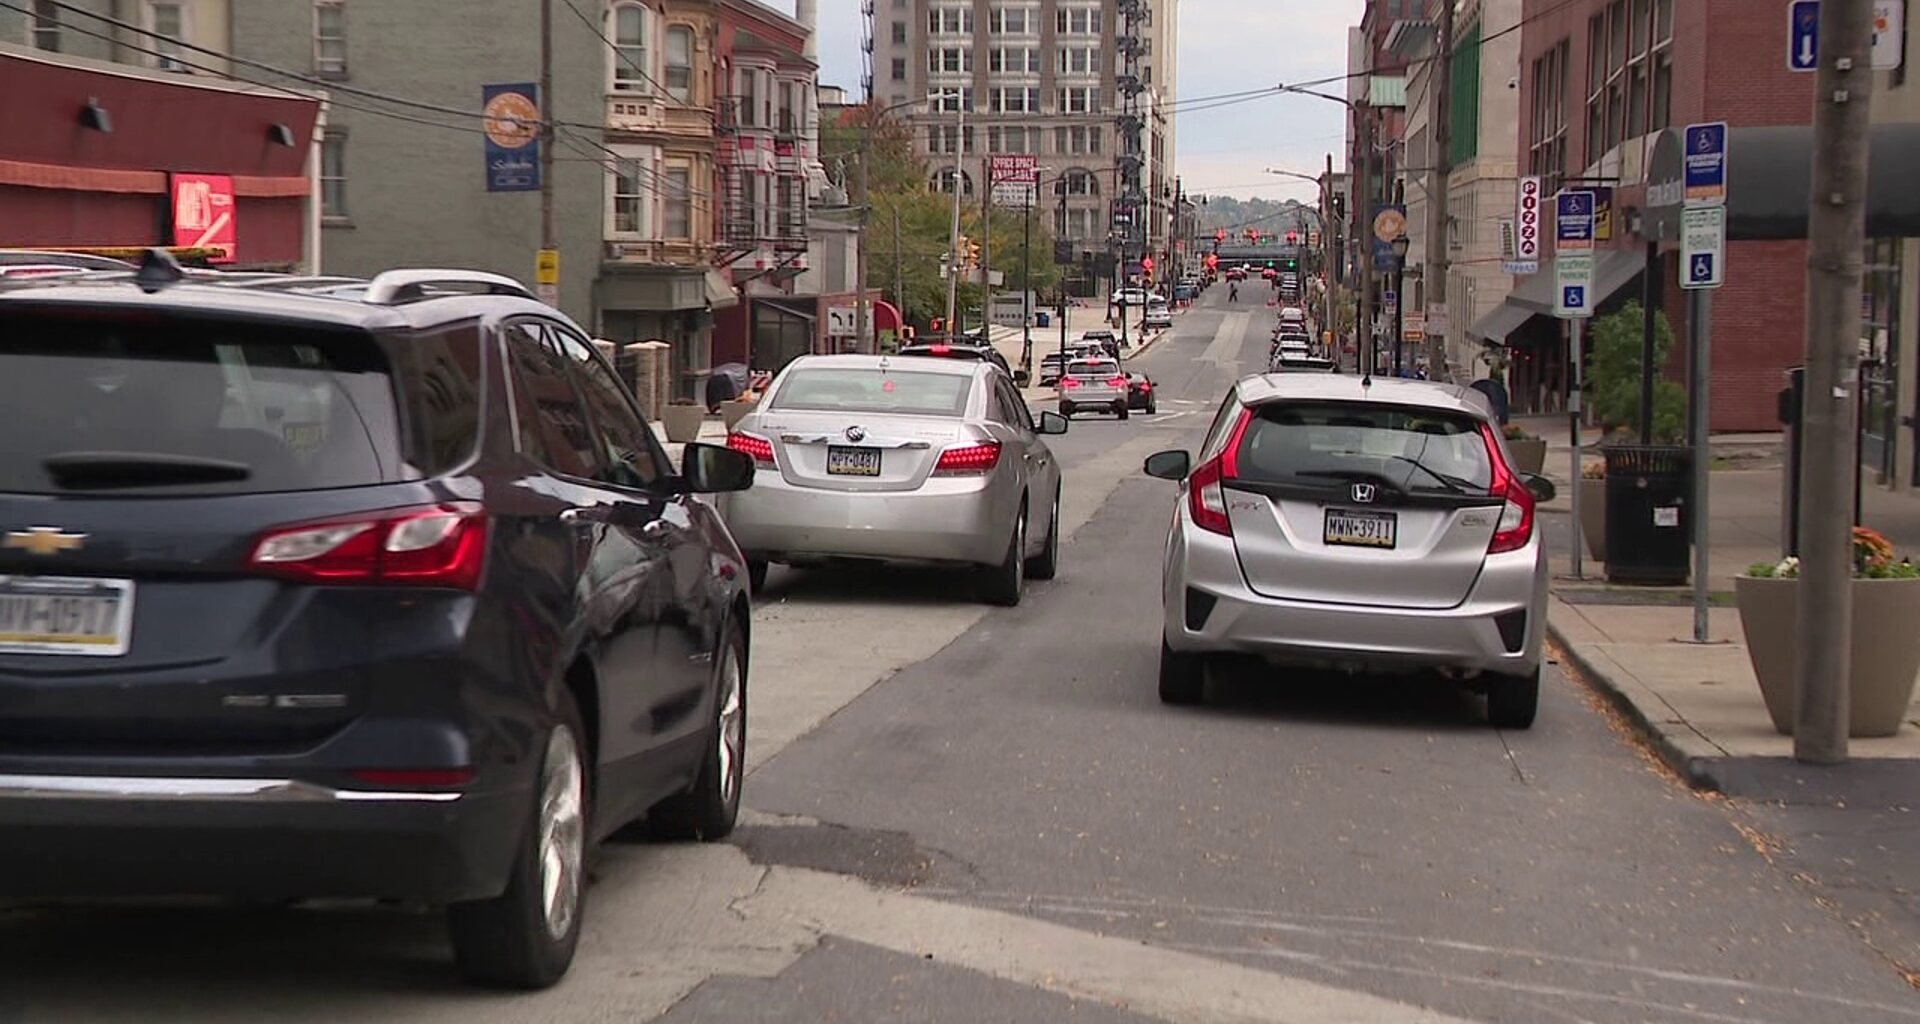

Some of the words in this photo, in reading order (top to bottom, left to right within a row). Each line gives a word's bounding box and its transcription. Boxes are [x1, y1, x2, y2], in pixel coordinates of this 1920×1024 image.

[993, 157, 1014, 169] OFFICE
[1015, 157, 1034, 168] SPACE
[1522, 181, 1536, 254] PIZZA
